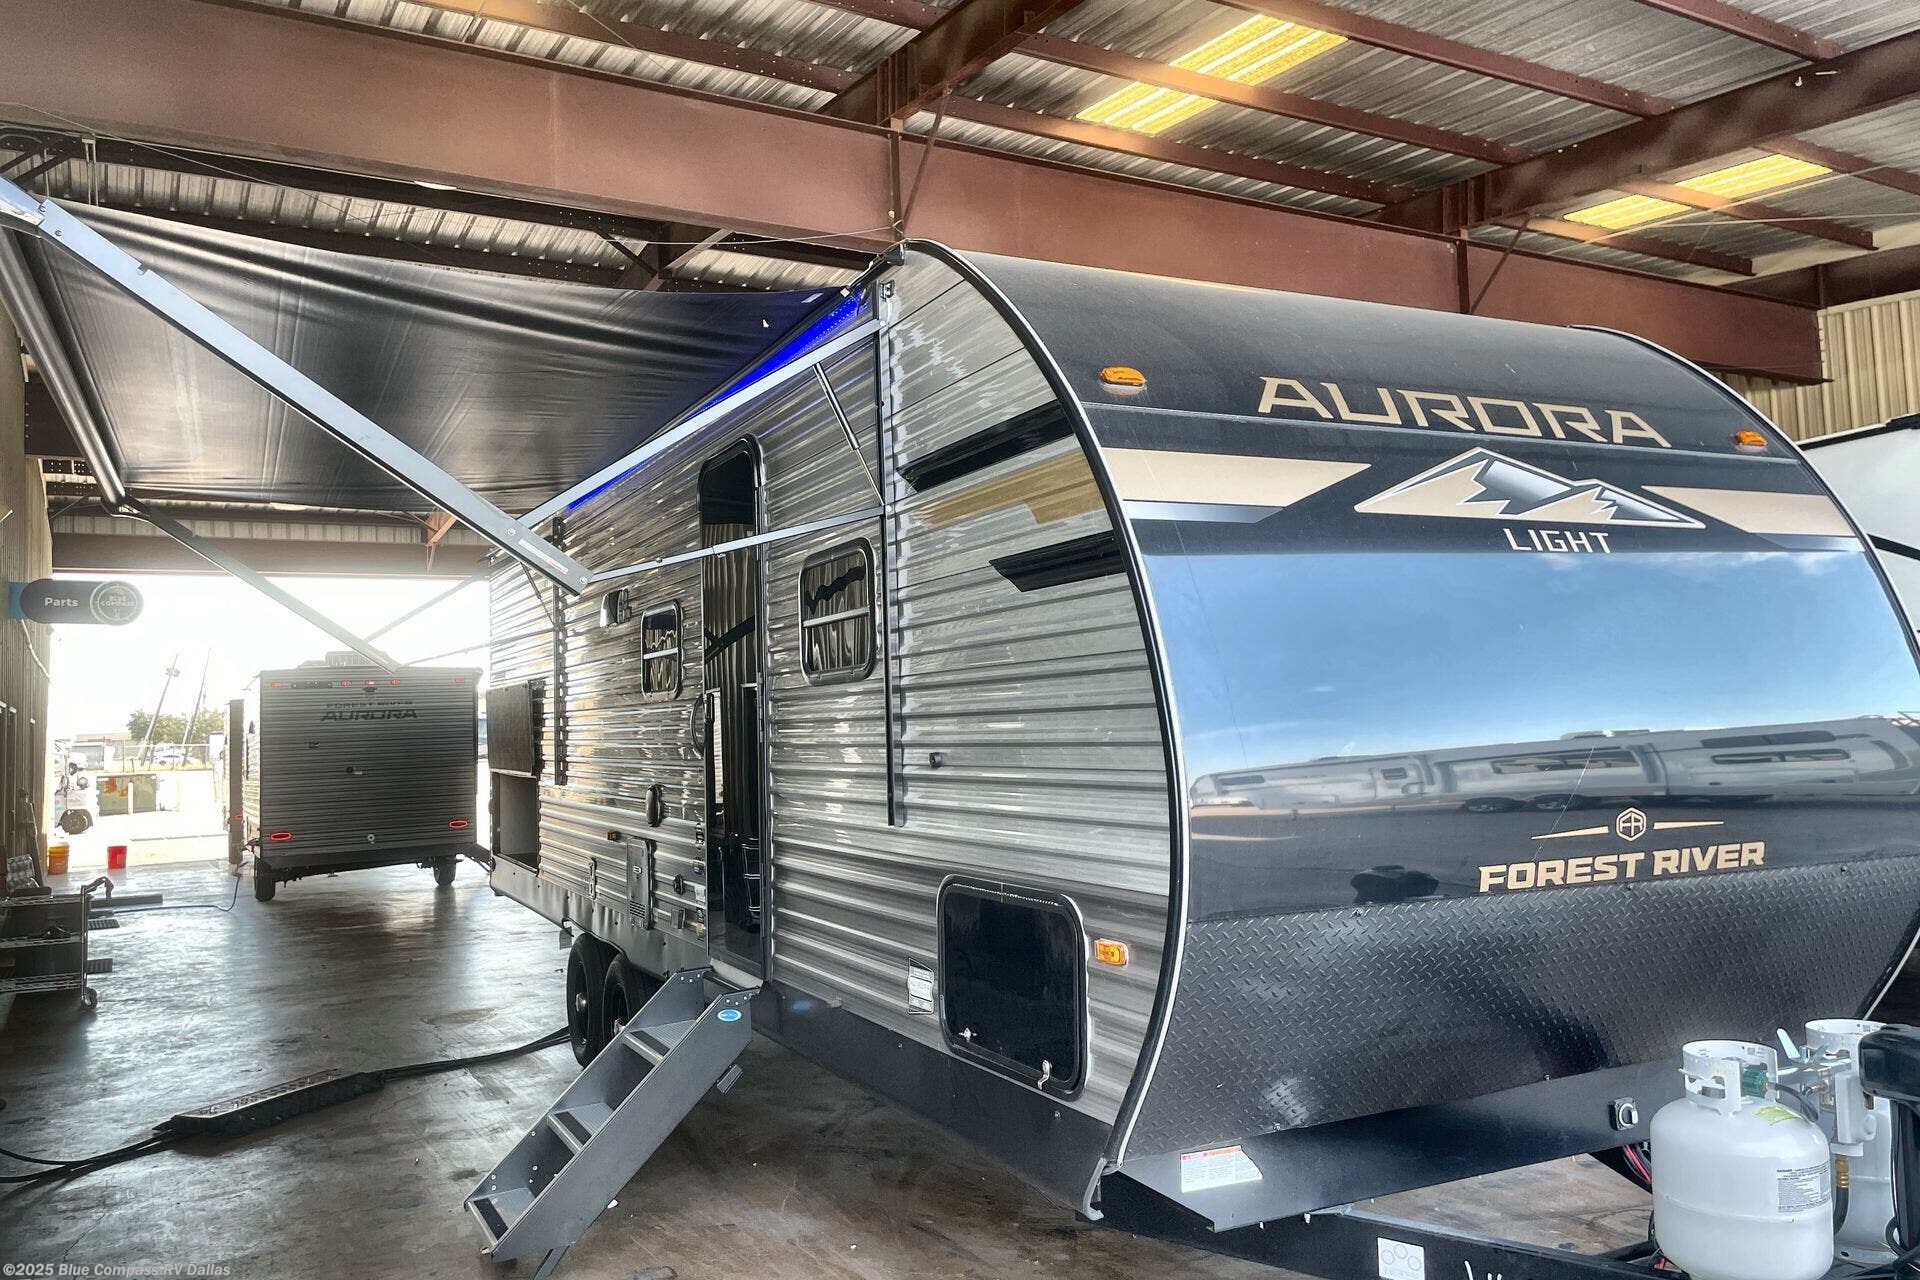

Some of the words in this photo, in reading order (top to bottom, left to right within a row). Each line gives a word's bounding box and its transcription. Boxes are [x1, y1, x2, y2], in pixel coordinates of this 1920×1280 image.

[1258, 376, 1672, 448] AURORA
[1503, 528, 1612, 554] LIGHT
[44, 597, 80, 607] Parts
[320, 709, 418, 721] AURORA
[1478, 852, 1645, 893] FOREST
[1652, 841, 1766, 876] RIVER
